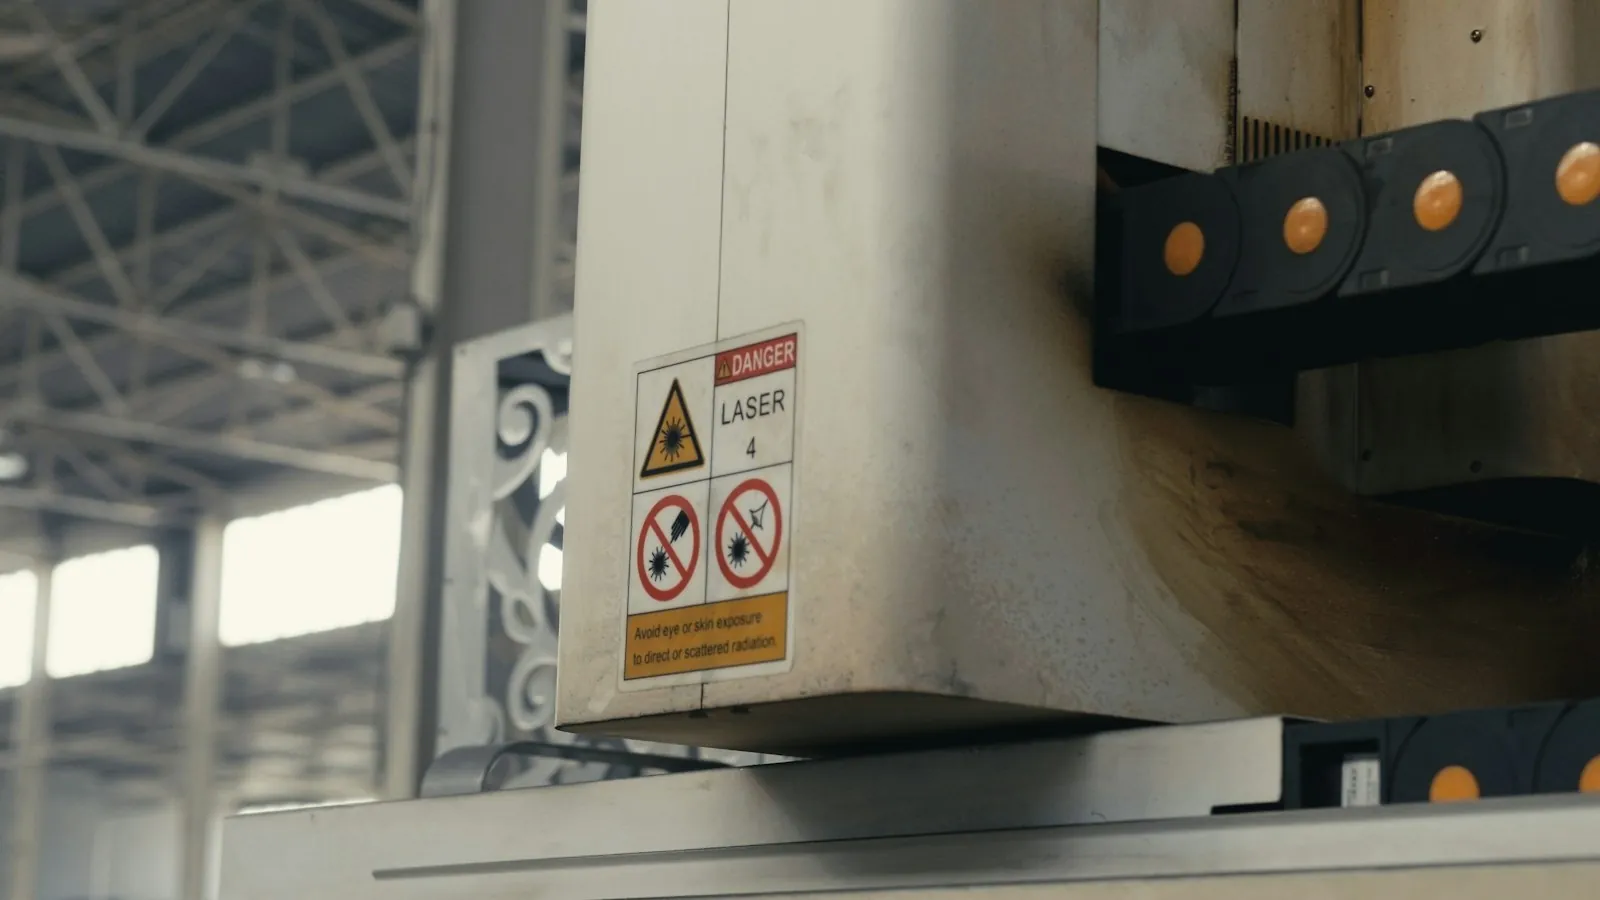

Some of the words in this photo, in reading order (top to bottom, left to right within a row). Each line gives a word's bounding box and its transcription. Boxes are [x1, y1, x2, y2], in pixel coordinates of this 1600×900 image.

[732, 340, 795, 377] DANGER
[721, 389, 785, 425] LASER
[746, 436, 756, 459] 4
[634, 625, 661, 640] Avoid
[662, 623, 679, 639] eye
[682, 622, 693, 634] or
[694, 619, 714, 632] skin
[716, 611, 763, 631] exposure
[633, 653, 642, 665] to
[644, 650, 670, 664] direct
[672, 648, 682, 660] or
[684, 642, 729, 658] scattered
[731, 635, 776, 653] radiation.
